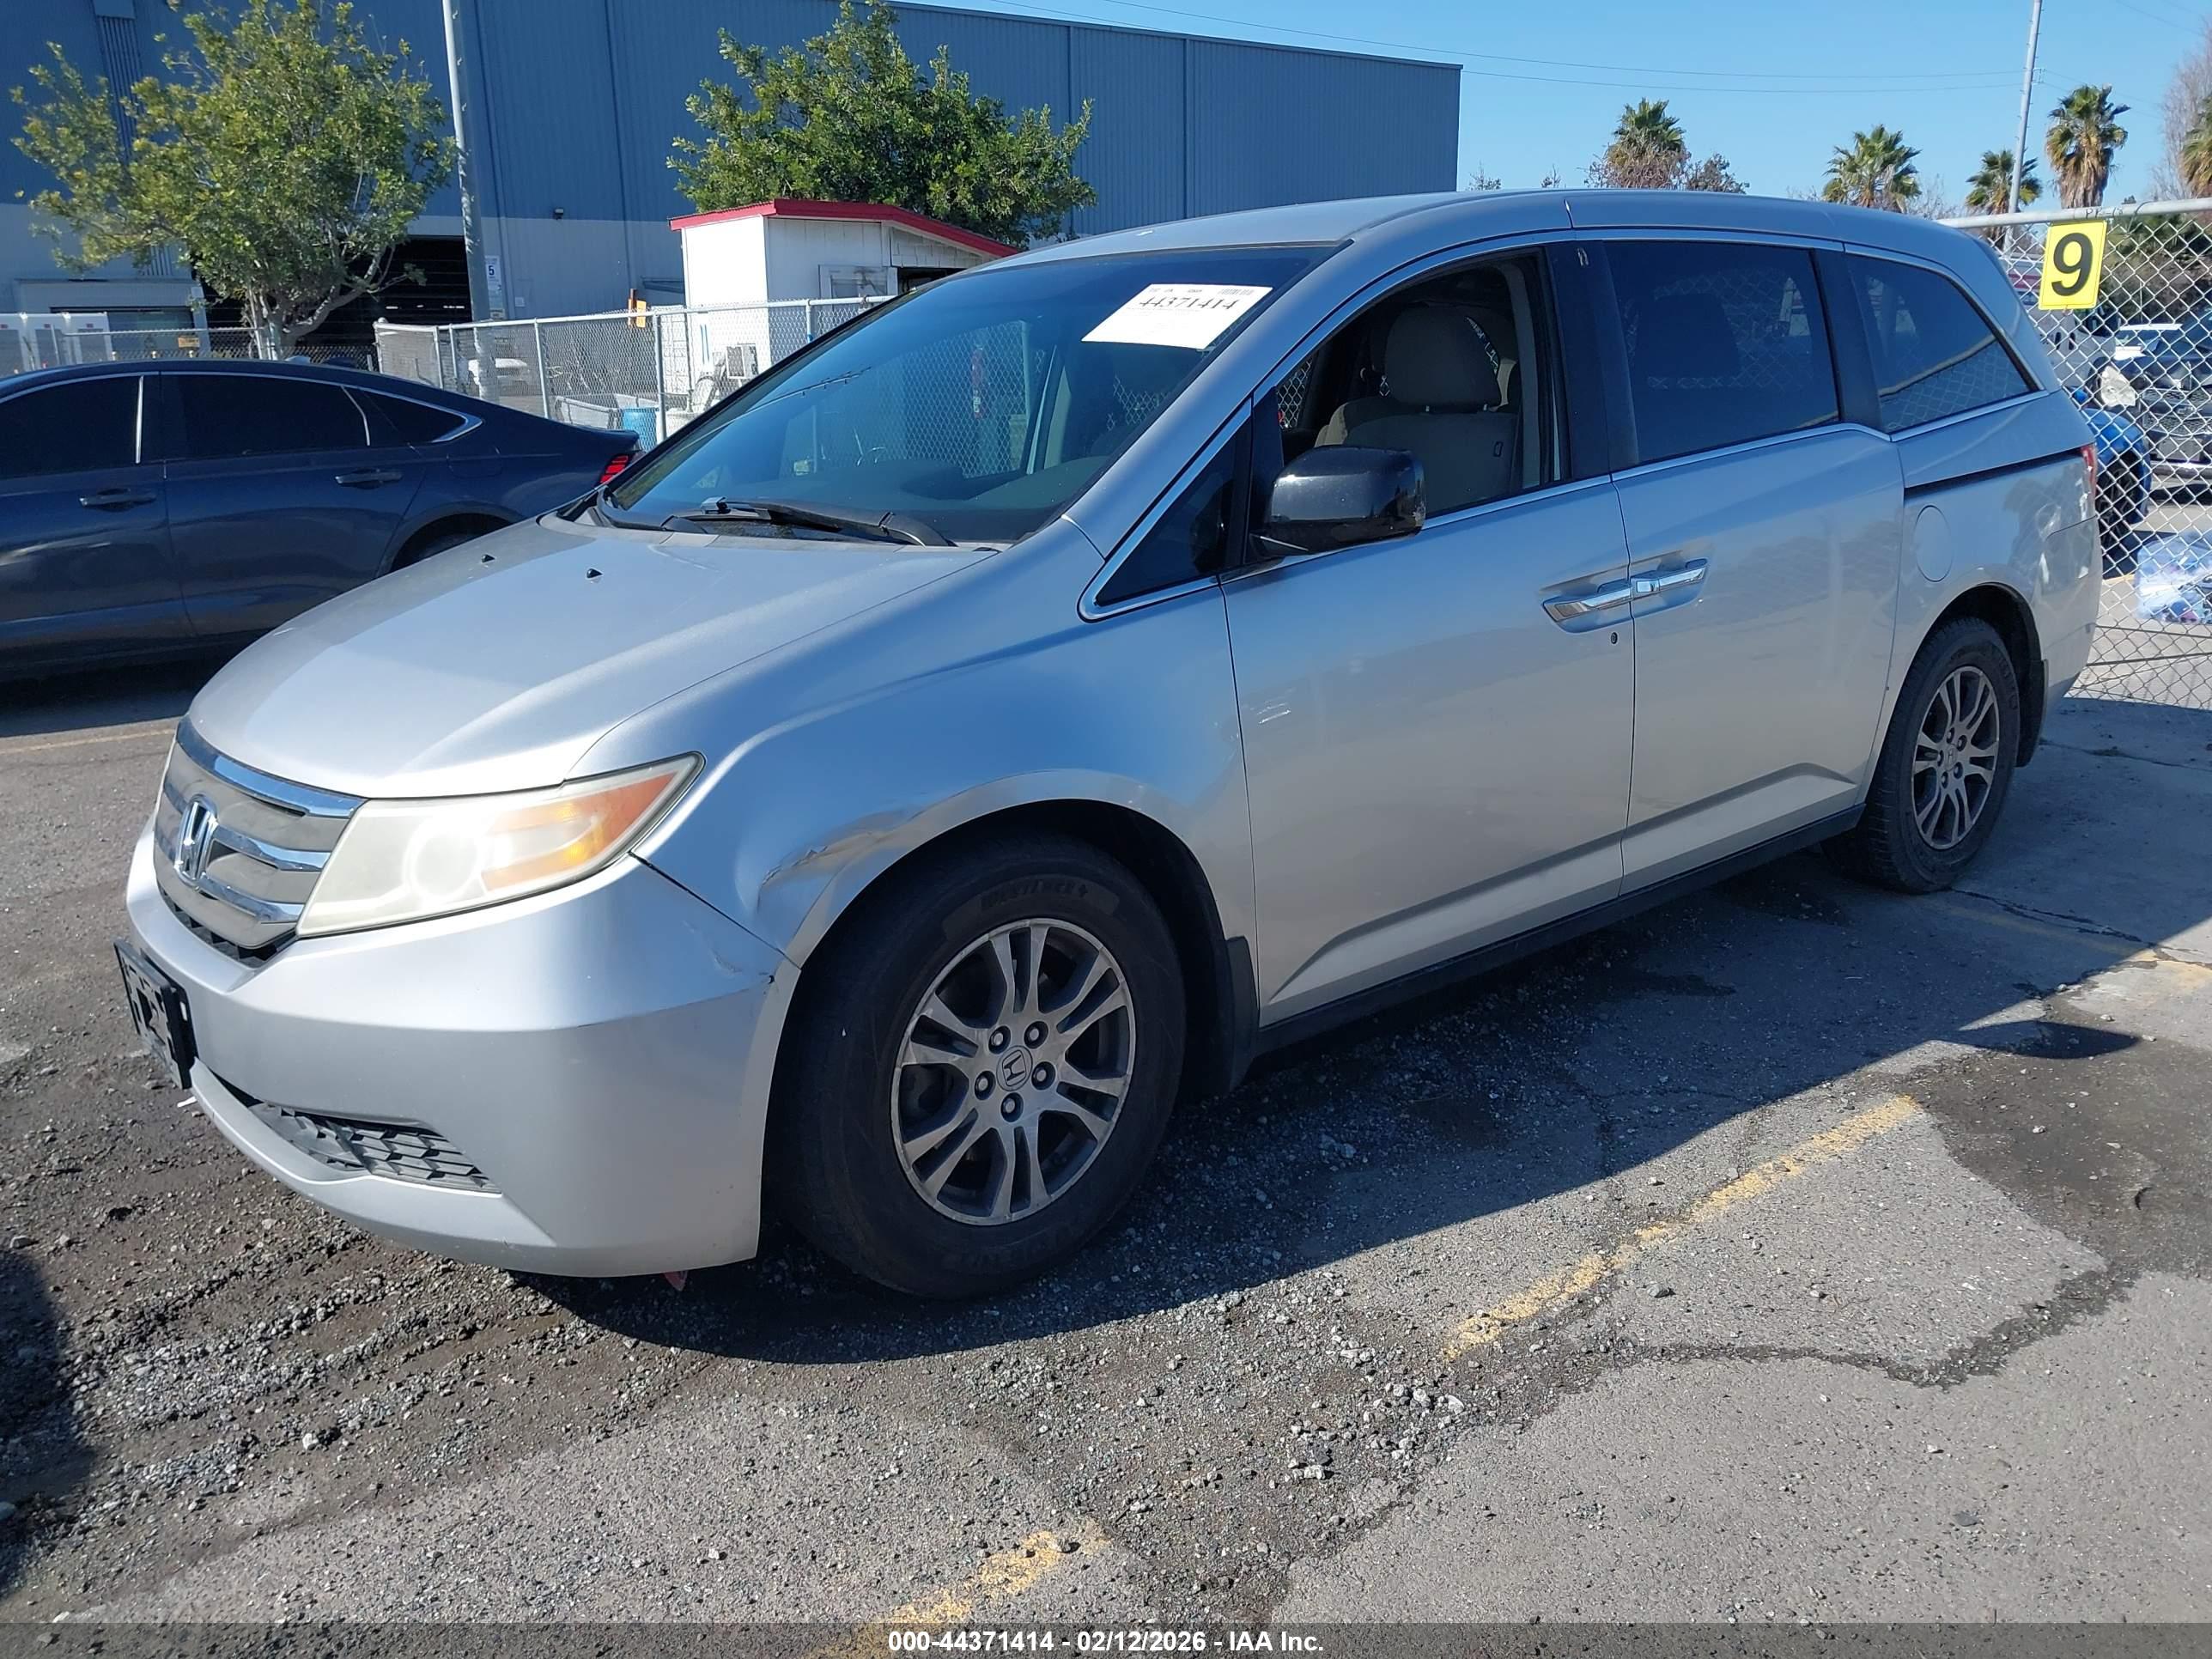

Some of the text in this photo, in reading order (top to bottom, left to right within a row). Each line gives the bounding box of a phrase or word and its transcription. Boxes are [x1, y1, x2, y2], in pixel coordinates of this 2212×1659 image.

[489, 265, 495, 276] 5
[2051, 233, 2094, 296] 9
[1139, 297, 1239, 309] 44371414
